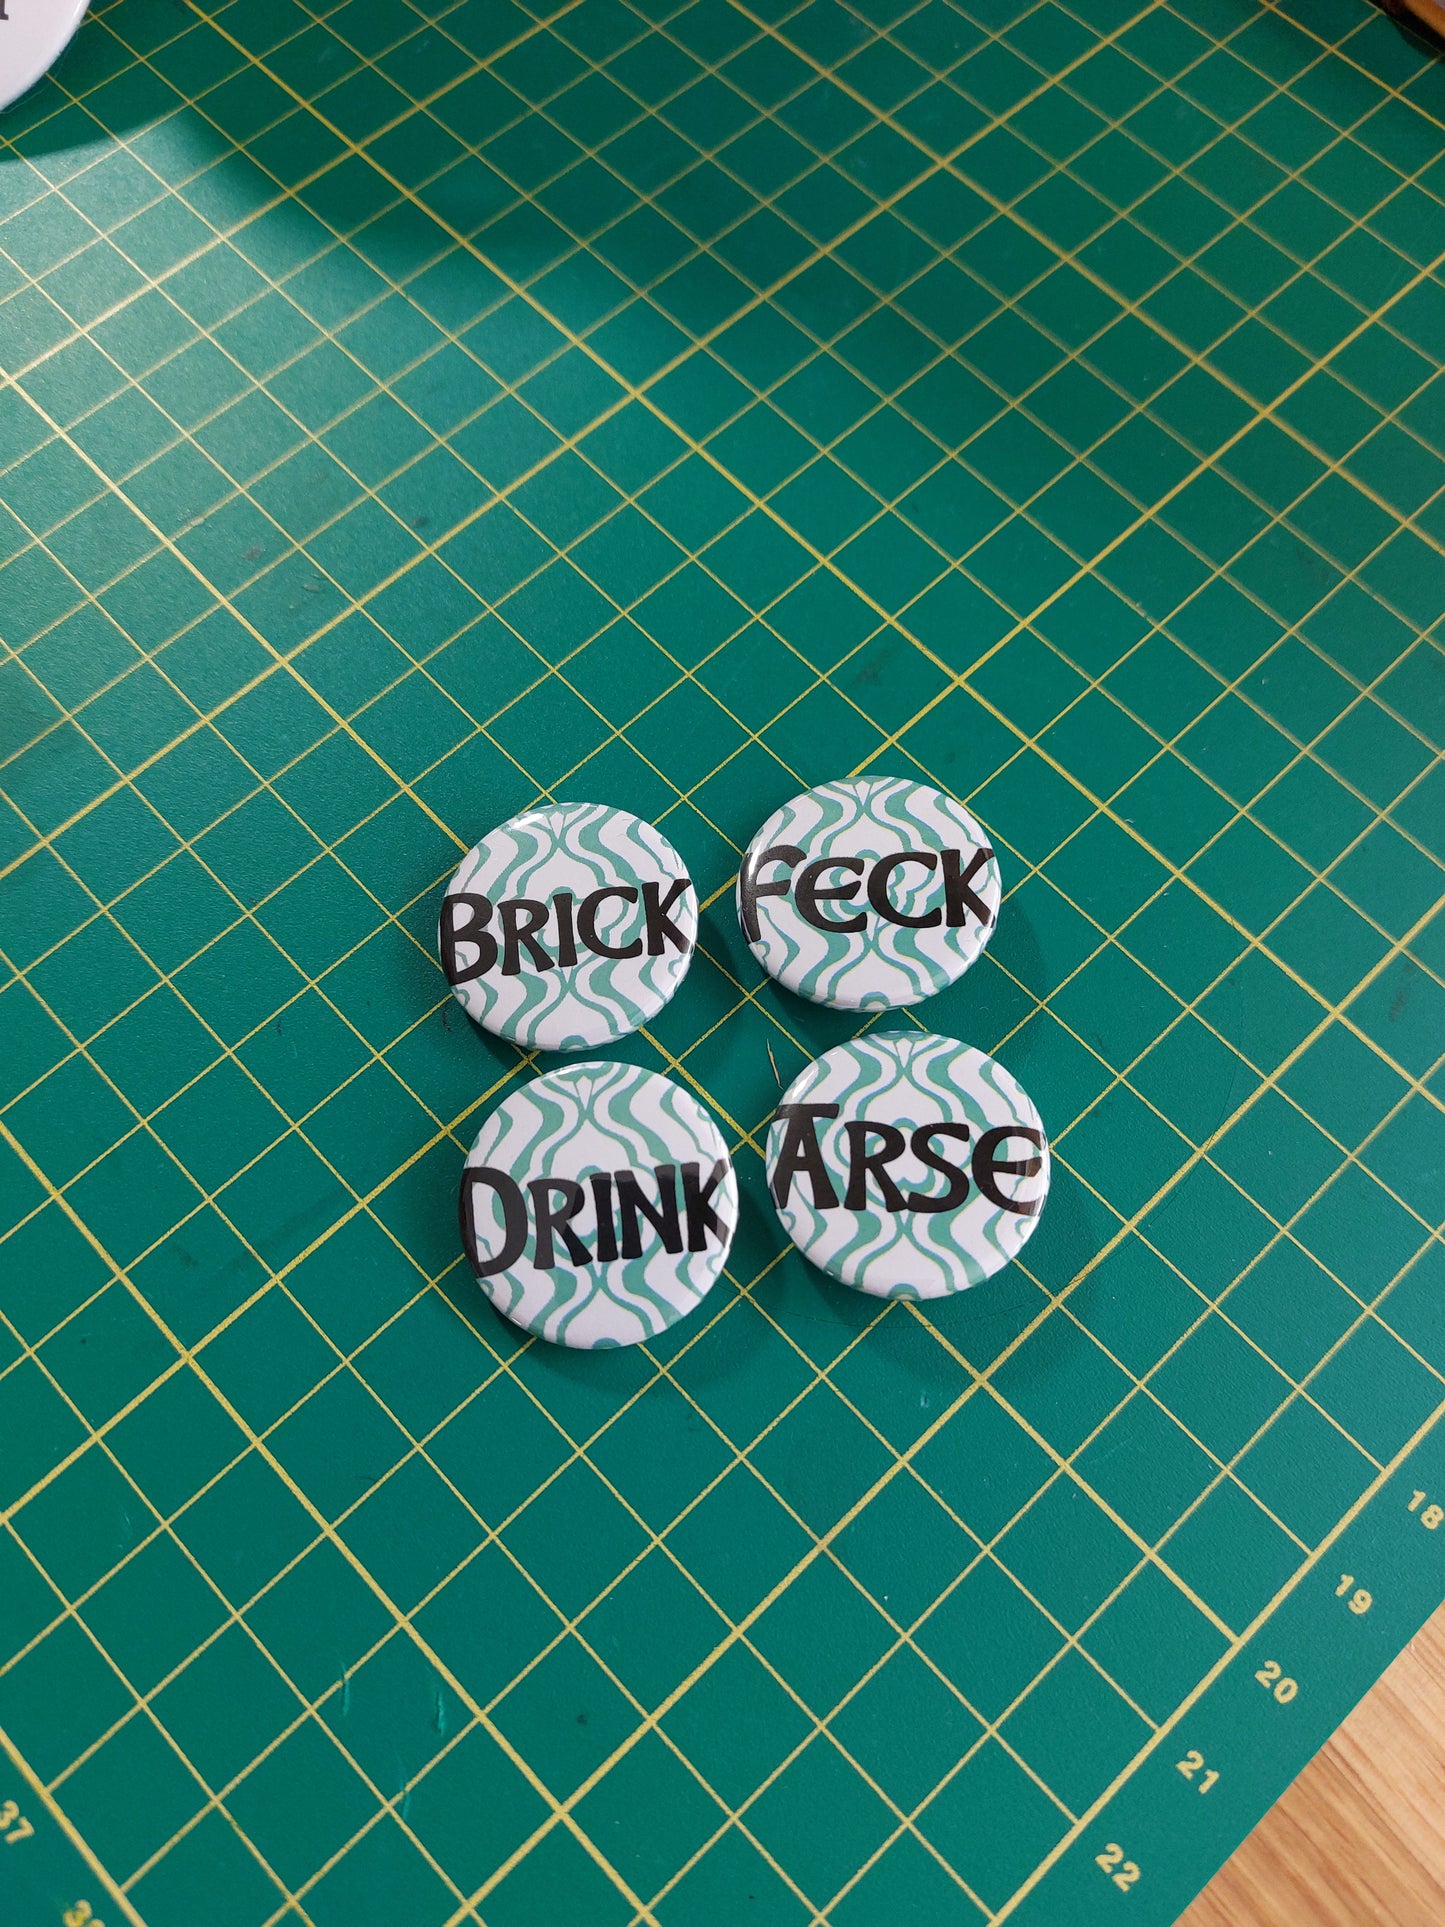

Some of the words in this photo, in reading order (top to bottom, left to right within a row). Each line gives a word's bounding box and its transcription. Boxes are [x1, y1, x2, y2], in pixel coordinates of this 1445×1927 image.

[738, 844, 998, 943] FECK
[440, 878, 694, 985] BRICK
[770, 1103, 1047, 1217] ARSE
[459, 1160, 733, 1277] DRINK
[1406, 1490, 1445, 1530] 18
[1335, 1573, 1373, 1615] 19
[1254, 1660, 1299, 1704] 20
[1175, 1750, 1220, 1794] 21
[0, 1800, 35, 1844] 37
[1095, 1842, 1141, 1893] 22
